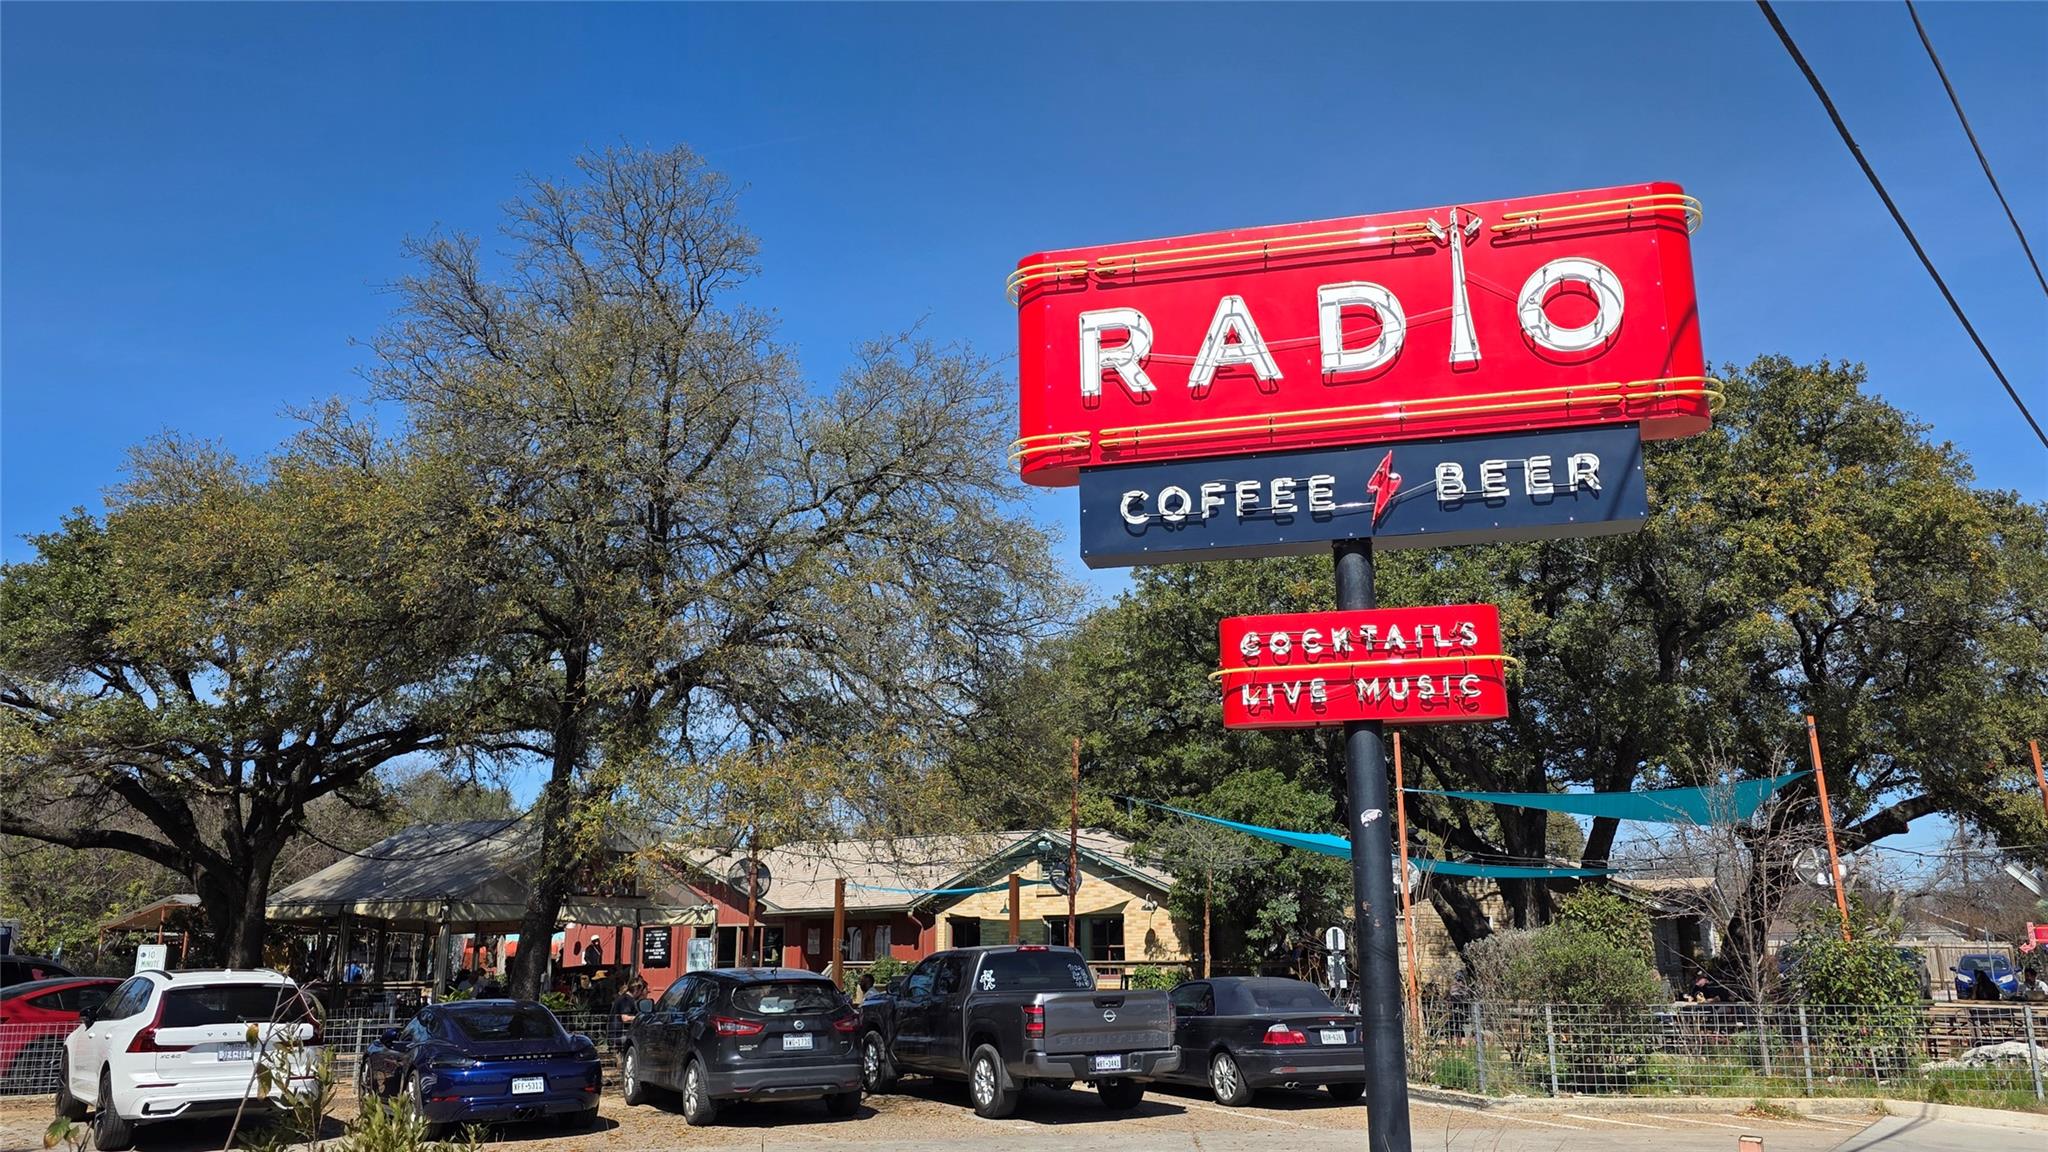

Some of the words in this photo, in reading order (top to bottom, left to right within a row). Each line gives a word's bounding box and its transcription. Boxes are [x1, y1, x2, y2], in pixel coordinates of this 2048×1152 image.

[1079, 207, 1625, 396] RADIO
[1120, 474, 1335, 524] COFFEE
[1435, 452, 1602, 501] BEER
[1240, 622, 1478, 656] COCKTAILS
[1241, 677, 1327, 705] LIVE
[1357, 674, 1481, 701] MUSIC
